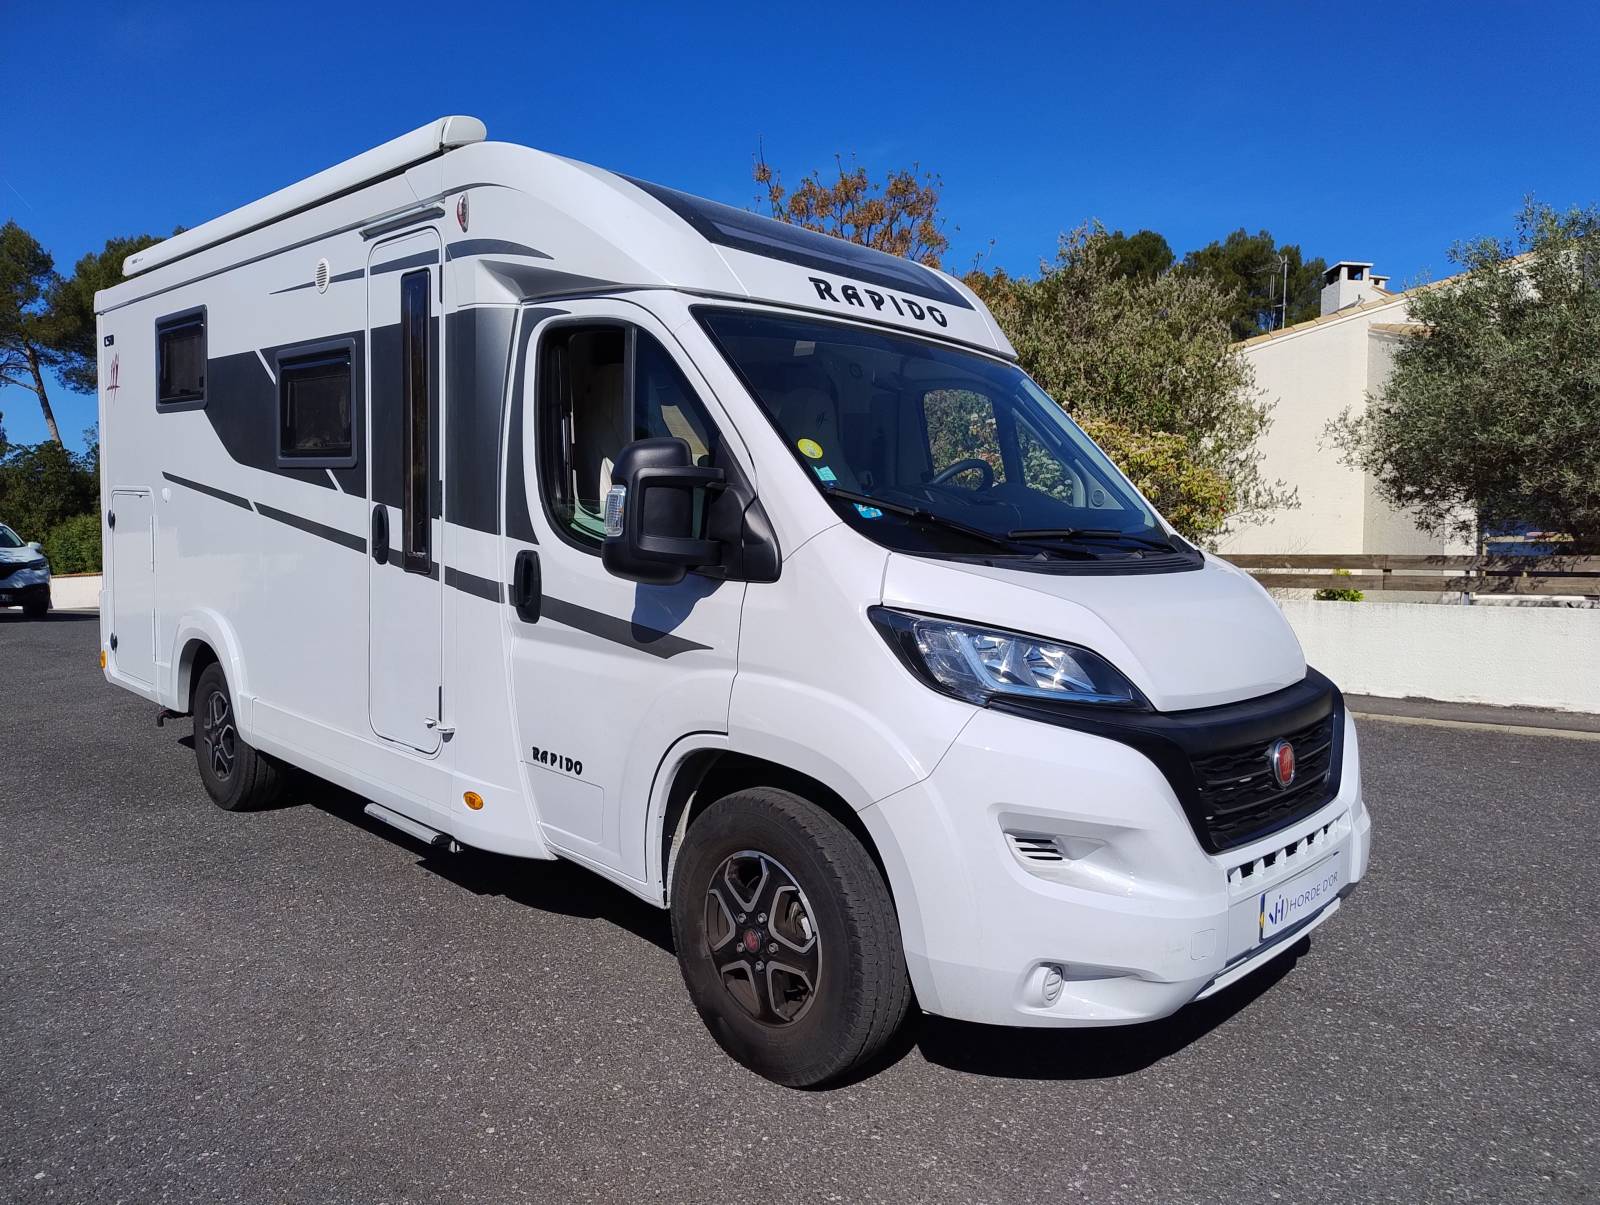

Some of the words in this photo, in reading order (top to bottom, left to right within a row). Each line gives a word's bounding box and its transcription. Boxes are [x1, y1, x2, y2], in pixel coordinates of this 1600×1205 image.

[808, 276, 948, 328] RAPIDO
[532, 746, 583, 776] RAPIDO
[1289, 883, 1320, 912] HORDE
